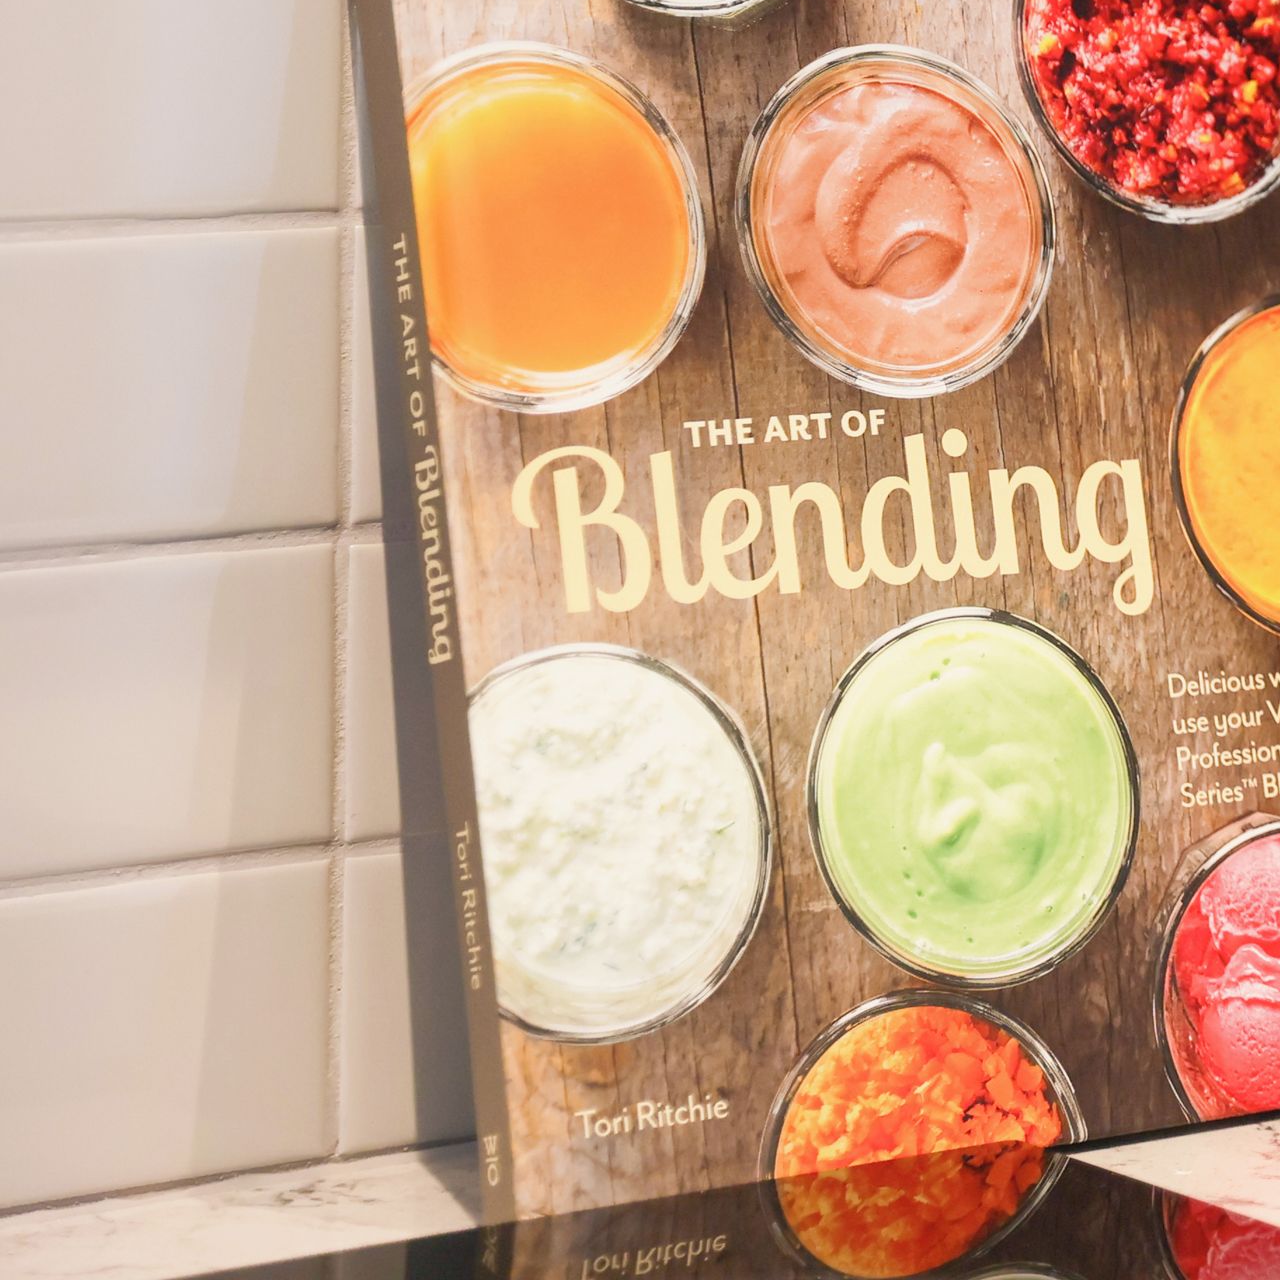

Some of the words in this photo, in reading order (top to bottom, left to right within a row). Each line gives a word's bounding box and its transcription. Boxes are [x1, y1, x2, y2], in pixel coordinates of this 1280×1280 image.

[392, 233, 412, 303] THE
[401, 314, 421, 380] ART
[409, 391, 427, 437] OF
[683, 417, 755, 448] THE
[764, 412, 832, 443] ART
[841, 408, 886, 438] OF
[511, 428, 1154, 616] Blending
[414, 443, 455, 665] Blending
[1167, 671, 1265, 699] Delicious
[1172, 715, 1209, 735] use
[1214, 710, 1264, 737] your
[455, 821, 473, 881] Tori
[461, 888, 481, 991] Ritchie
[574, 1109, 630, 1140] Tori
[637, 1094, 729, 1131] Ritchie
